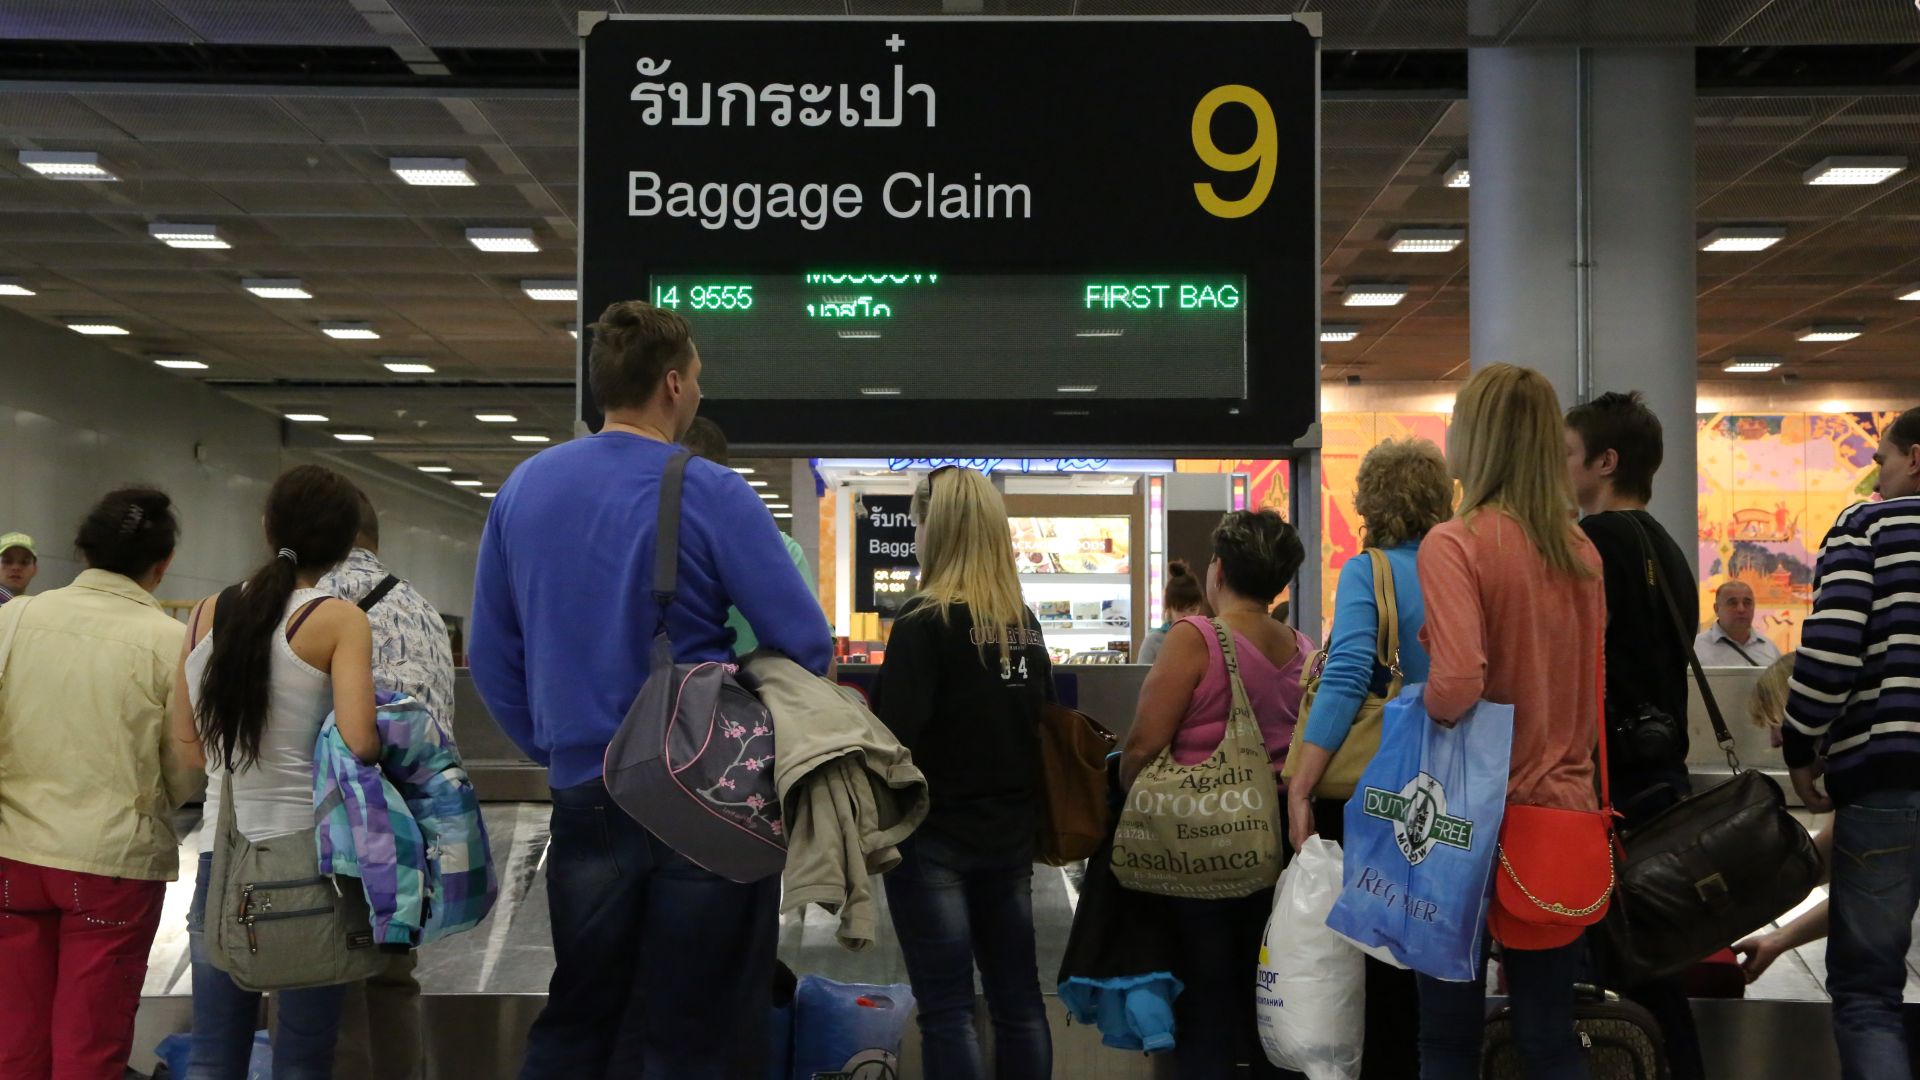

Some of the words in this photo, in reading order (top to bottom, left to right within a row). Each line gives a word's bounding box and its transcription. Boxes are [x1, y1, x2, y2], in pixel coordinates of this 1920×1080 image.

[628, 33, 936, 127] รับกระเป๋า
[1192, 84, 1279, 219] 9
[628, 170, 863, 231] Baggage
[882, 171, 1032, 219] Claim
[690, 285, 753, 309] 9555
[1086, 285, 1171, 309] FIRST
[1180, 284, 1239, 308] BAG
[869, 539, 917, 558] Bagga
[1178, 766, 1254, 794] Agadir
[1176, 815, 1270, 840] Essaouira
[1366, 793, 1410, 819] DUTY
[1434, 818, 1467, 844] FREE
[1111, 845, 1261, 875] Casablanca
